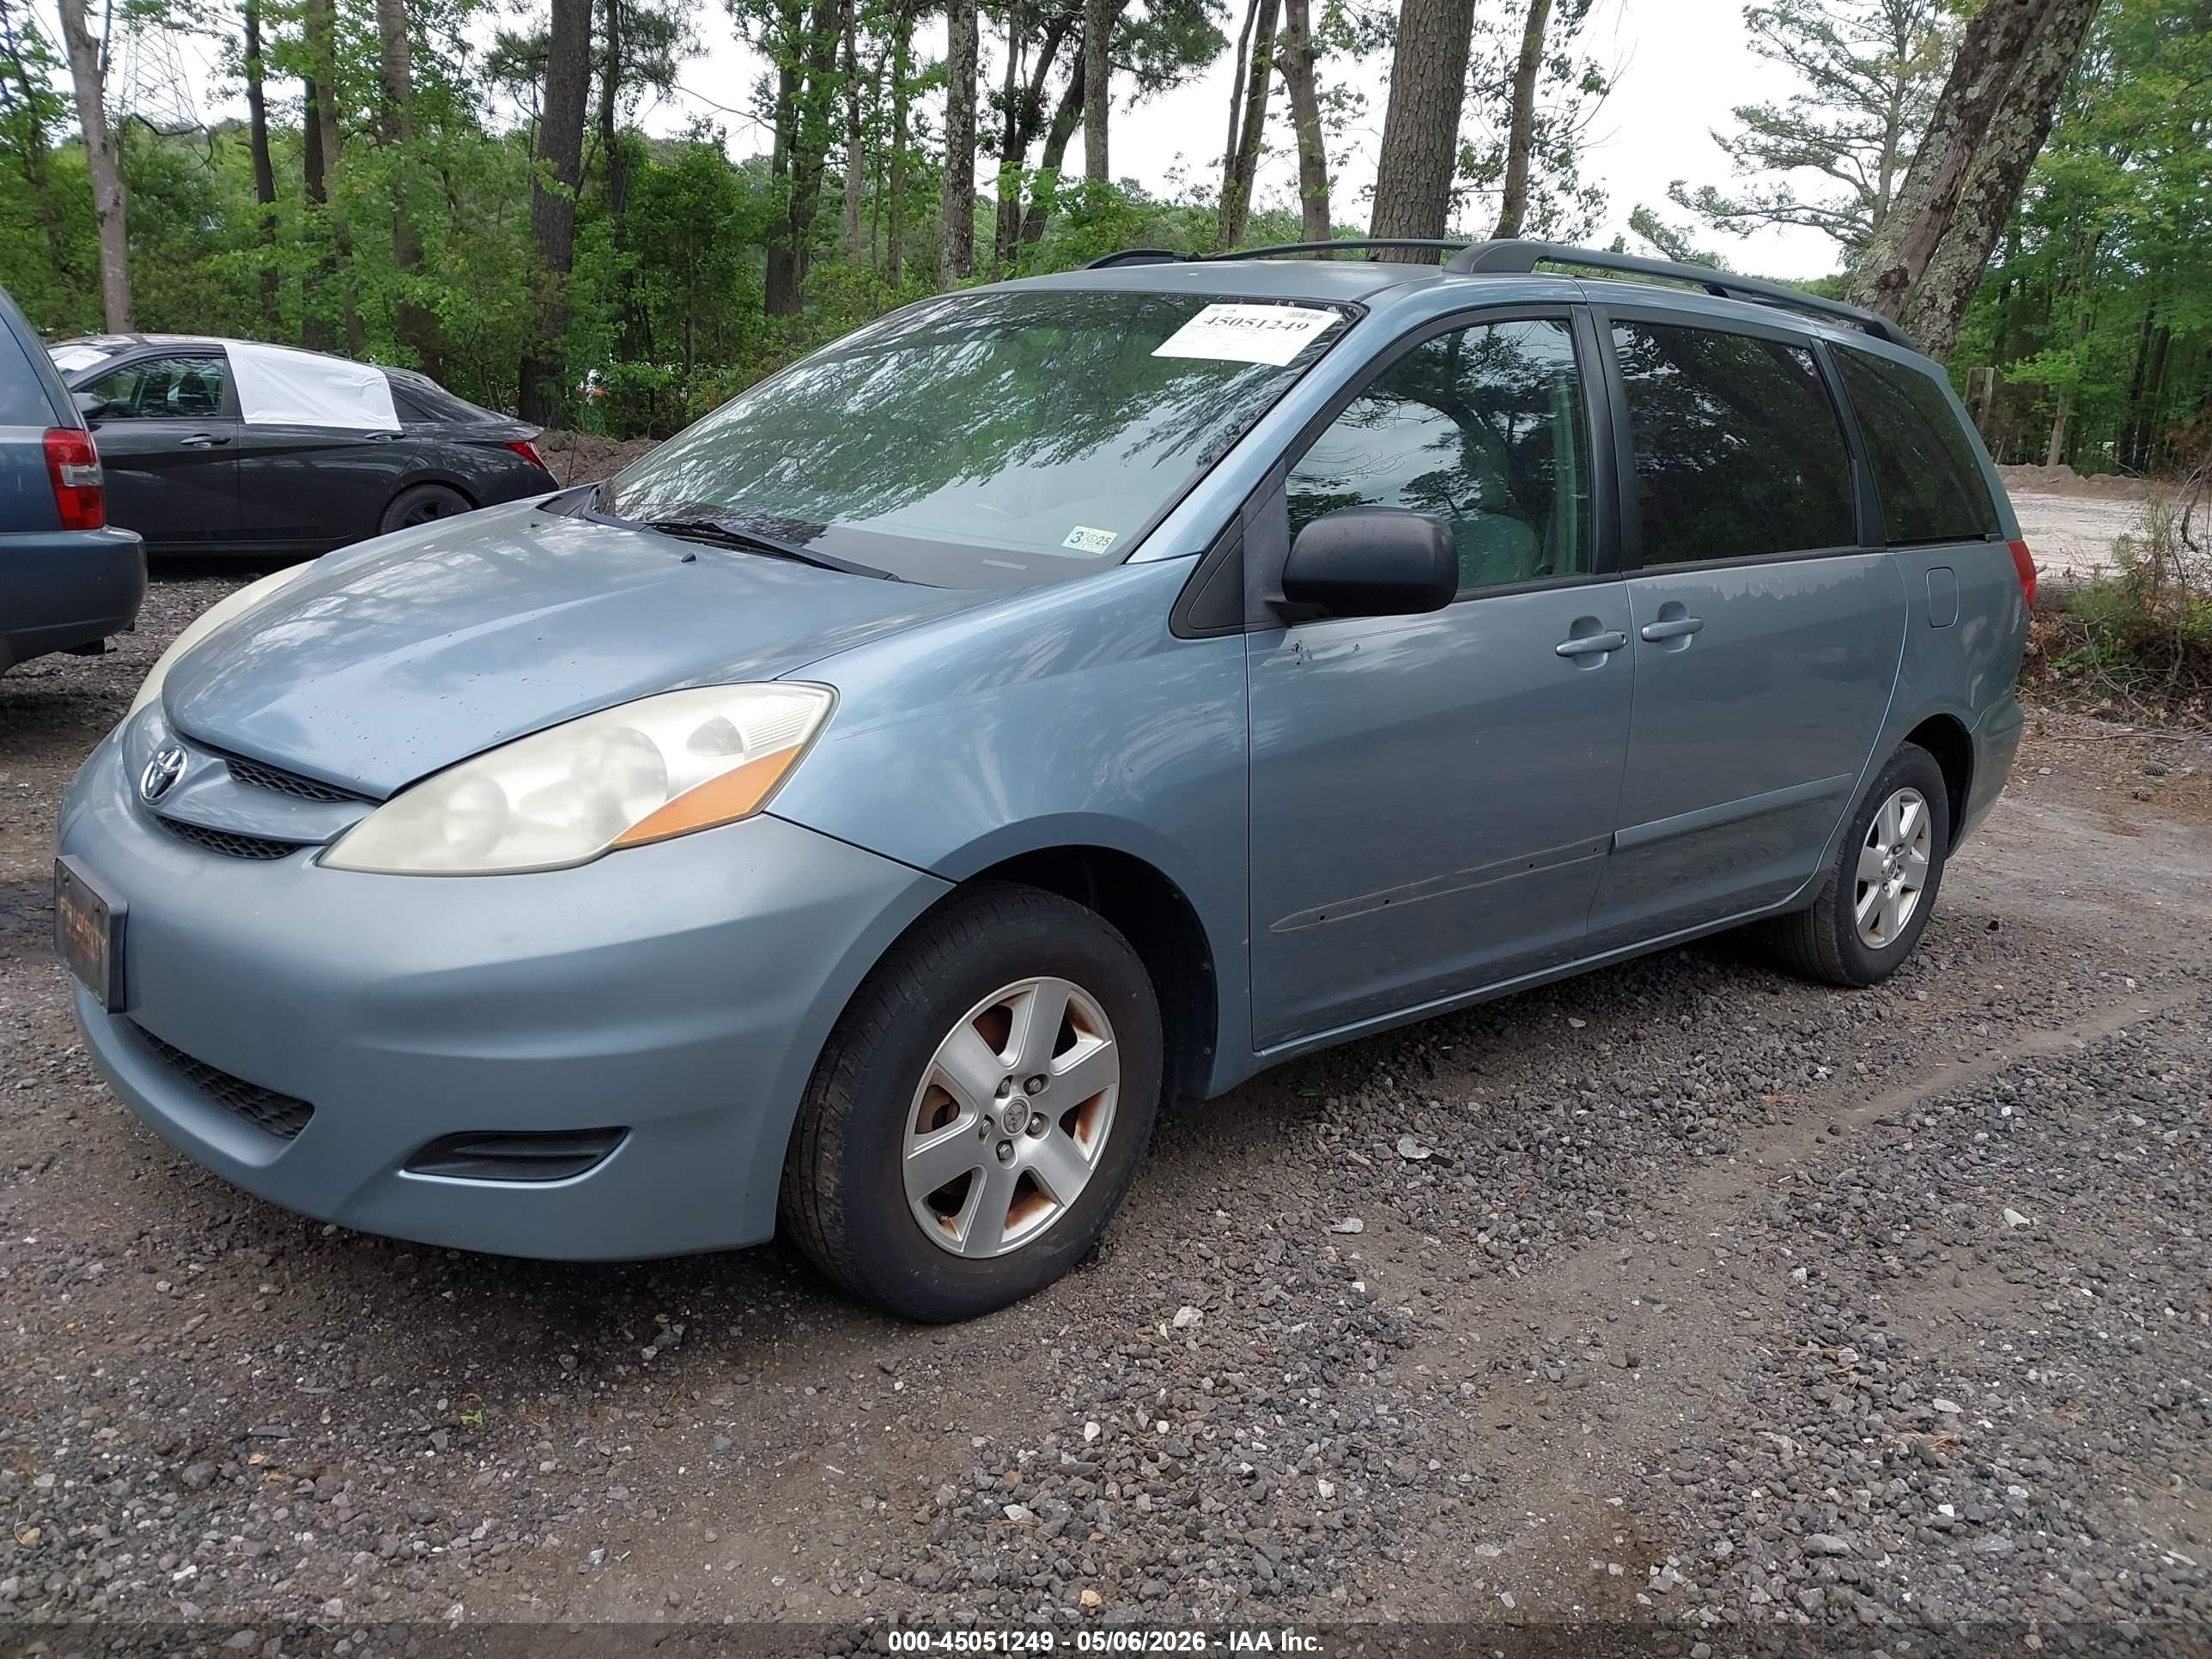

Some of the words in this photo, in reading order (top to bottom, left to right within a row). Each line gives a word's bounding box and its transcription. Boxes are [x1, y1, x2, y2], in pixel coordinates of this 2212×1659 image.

[1203, 315, 1310, 331] 45051249
[1070, 531, 1085, 544] 3
[1096, 536, 1112, 546] 25
